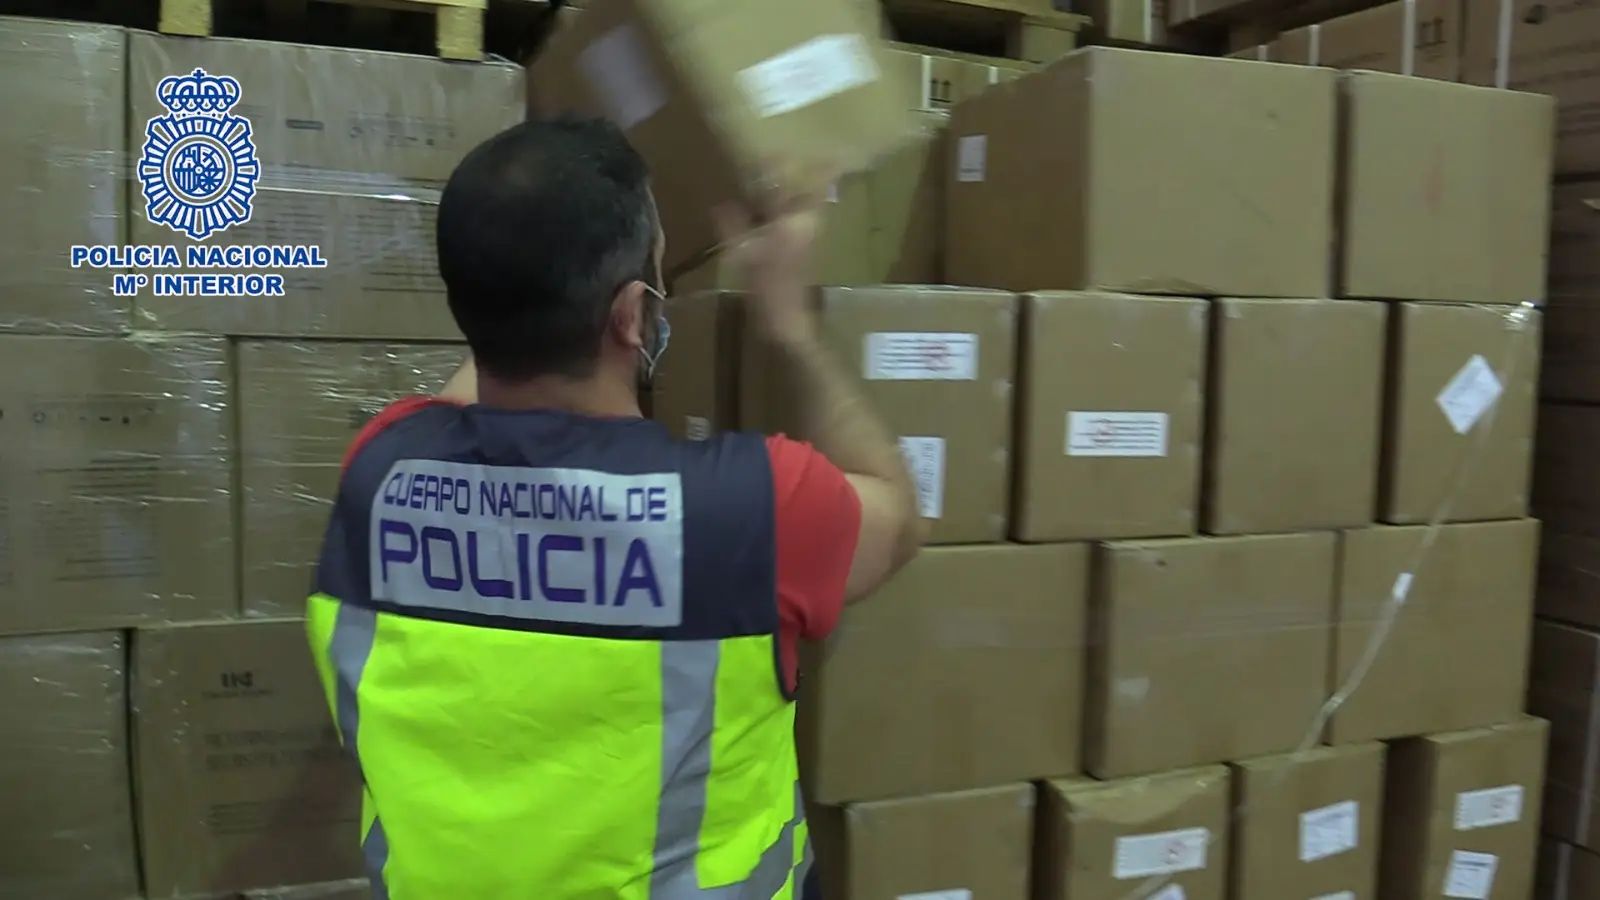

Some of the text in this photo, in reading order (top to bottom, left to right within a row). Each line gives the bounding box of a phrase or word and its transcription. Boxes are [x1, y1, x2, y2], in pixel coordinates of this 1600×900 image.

[383, 473, 668, 522] CUERPO NACIONAL DE
[379, 518, 664, 608] POLICIA
